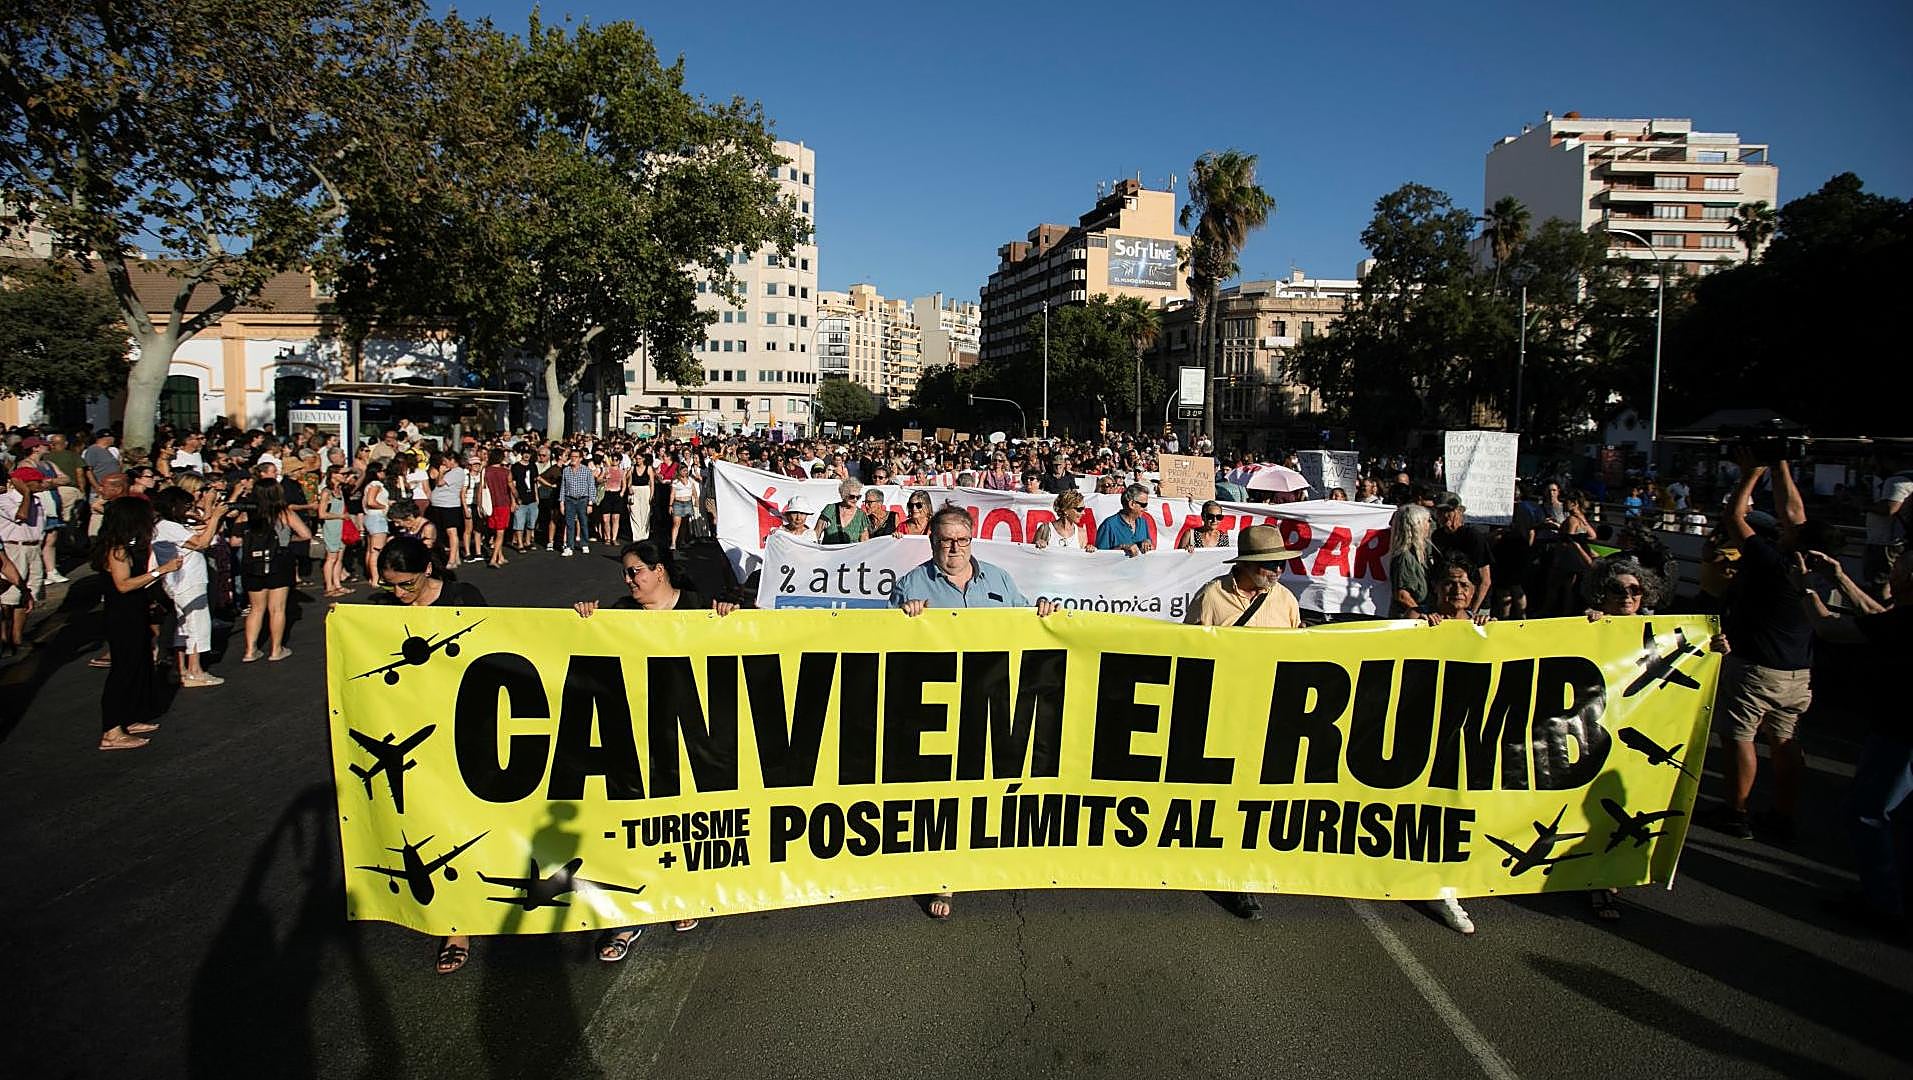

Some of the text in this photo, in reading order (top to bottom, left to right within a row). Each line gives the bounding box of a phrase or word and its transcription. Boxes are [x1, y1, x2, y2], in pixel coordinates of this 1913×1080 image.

[808, 561, 897, 596] atta
[455, 649, 1613, 803] CANVIEM EL RUMB
[621, 807, 750, 850] TURISME
[770, 782, 1476, 864] POSEM LÍMITS AL TURISME
[682, 837, 751, 872] VIDA
